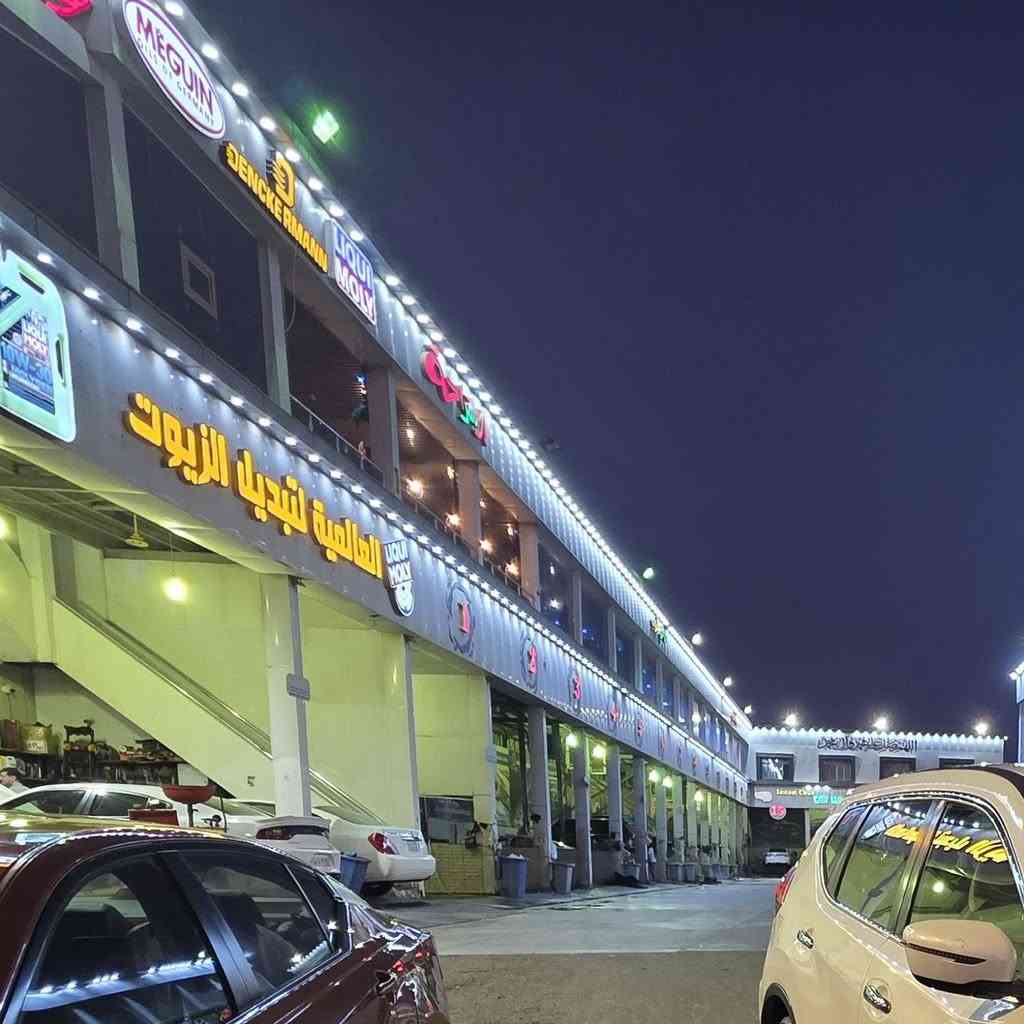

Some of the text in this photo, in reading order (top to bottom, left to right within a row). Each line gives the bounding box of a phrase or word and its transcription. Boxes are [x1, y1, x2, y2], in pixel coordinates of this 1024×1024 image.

[136, 6, 214, 116] MEGUIN
[225, 142, 329, 273] DENCKERMANN
[335, 224, 374, 291] LIQUI
[335, 258, 376, 324] MOLY
[129, 392, 384, 580] العالمية لتبديل الزيوت
[385, 540, 409, 563] LIQUI
[388, 562, 412, 586] MOLY
[457, 599, 471, 634] 1
